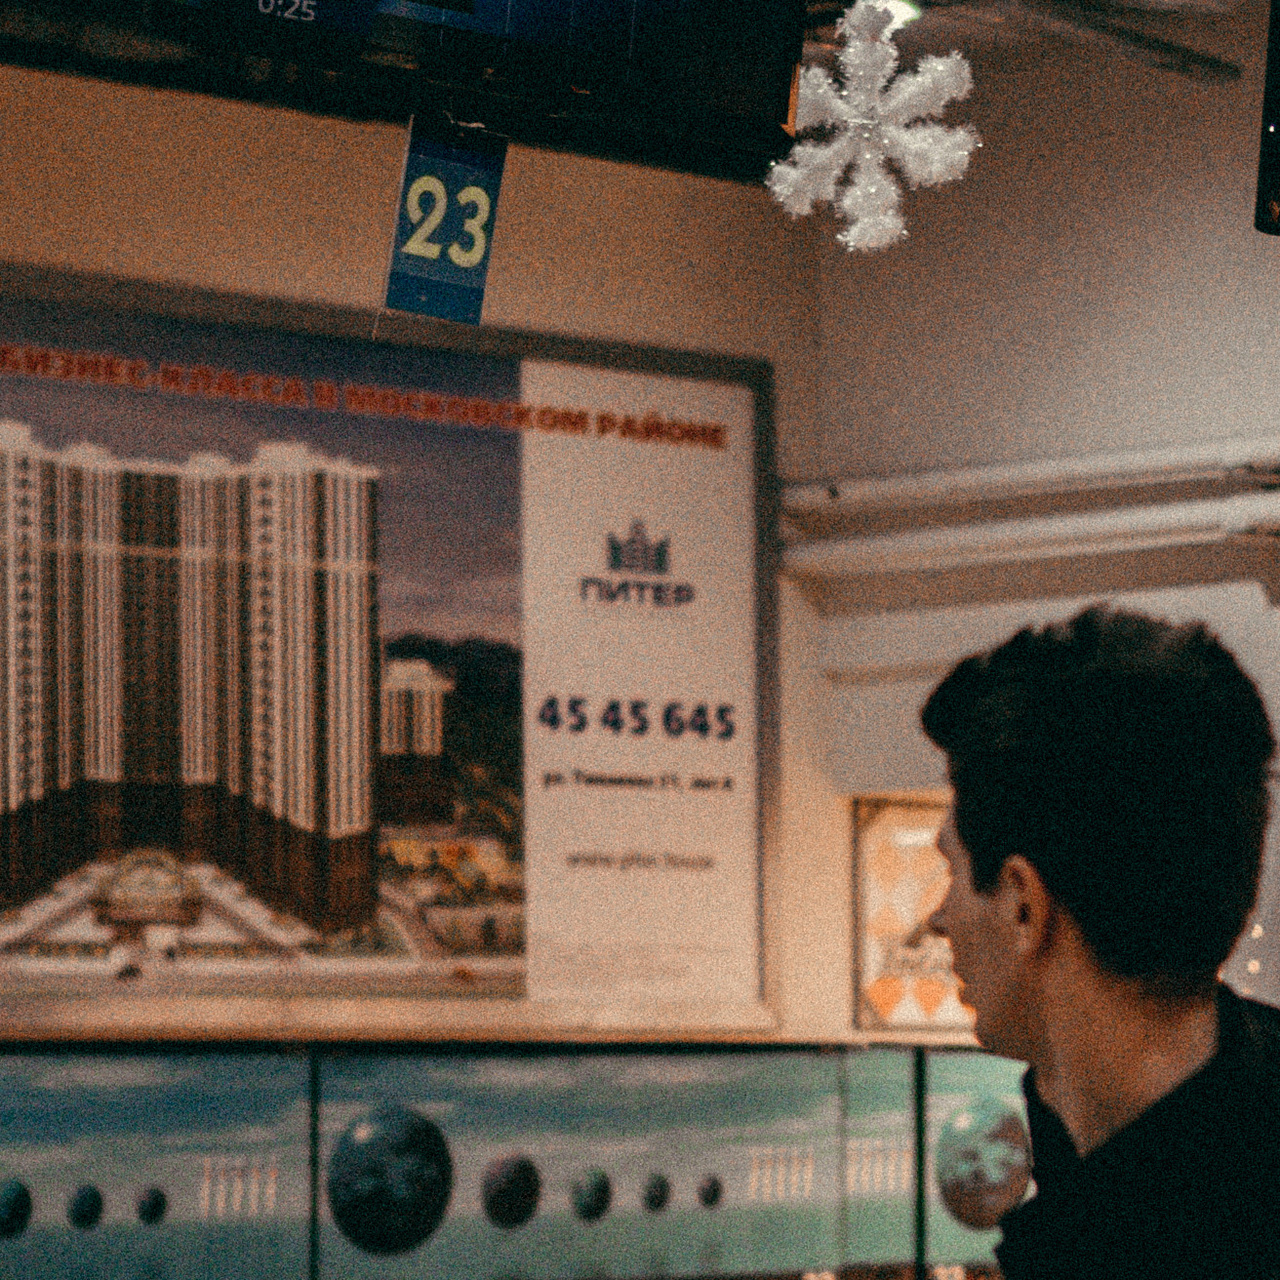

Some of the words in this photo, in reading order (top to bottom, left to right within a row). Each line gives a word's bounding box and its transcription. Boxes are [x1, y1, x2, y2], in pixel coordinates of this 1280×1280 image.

[401, 174, 491, 269] 23
[596, 408, 731, 453] РАЙОНЕ
[580, 577, 696, 608] ПИТЕР
[537, 696, 590, 735] 45
[601, 698, 649, 737] 45
[661, 701, 736, 741] 645
